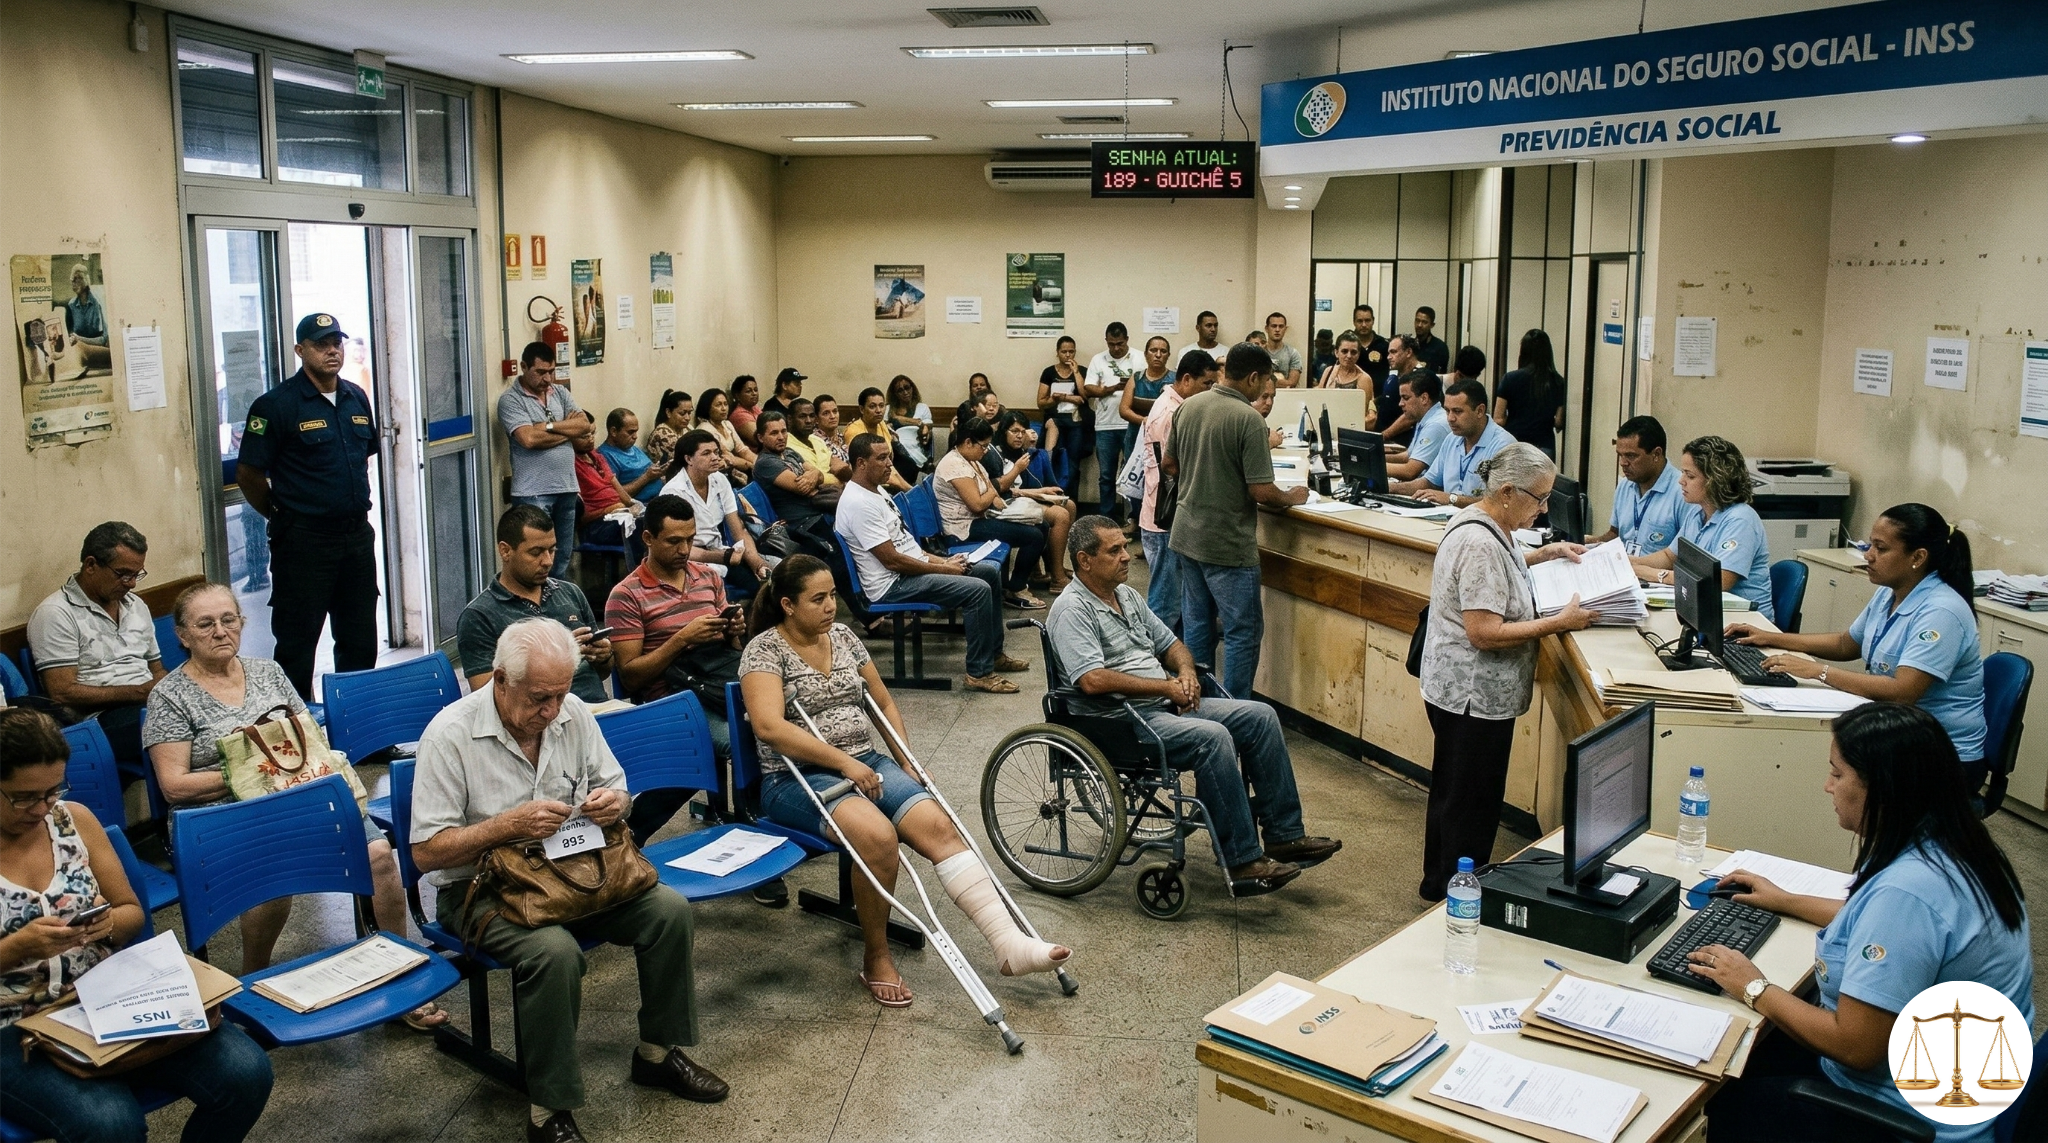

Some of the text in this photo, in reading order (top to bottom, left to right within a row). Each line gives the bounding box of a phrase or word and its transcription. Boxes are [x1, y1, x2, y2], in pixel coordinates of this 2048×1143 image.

[1381, 20, 1975, 113] INSTITUTO NACIONAL DO SEGURO SOCIAL - INSS
[1499, 110, 1782, 154] PREVIDÊNCIA SOCIAL
[1108, 149, 1237, 166] SENHA ATUAL:
[1104, 172, 1137, 188] 189
[1156, 166, 1224, 188] GUICHÊ
[1229, 172, 1242, 188] 5
[132, 1010, 171, 1024] INSS
[1314, 1006, 1340, 1024] INSS
